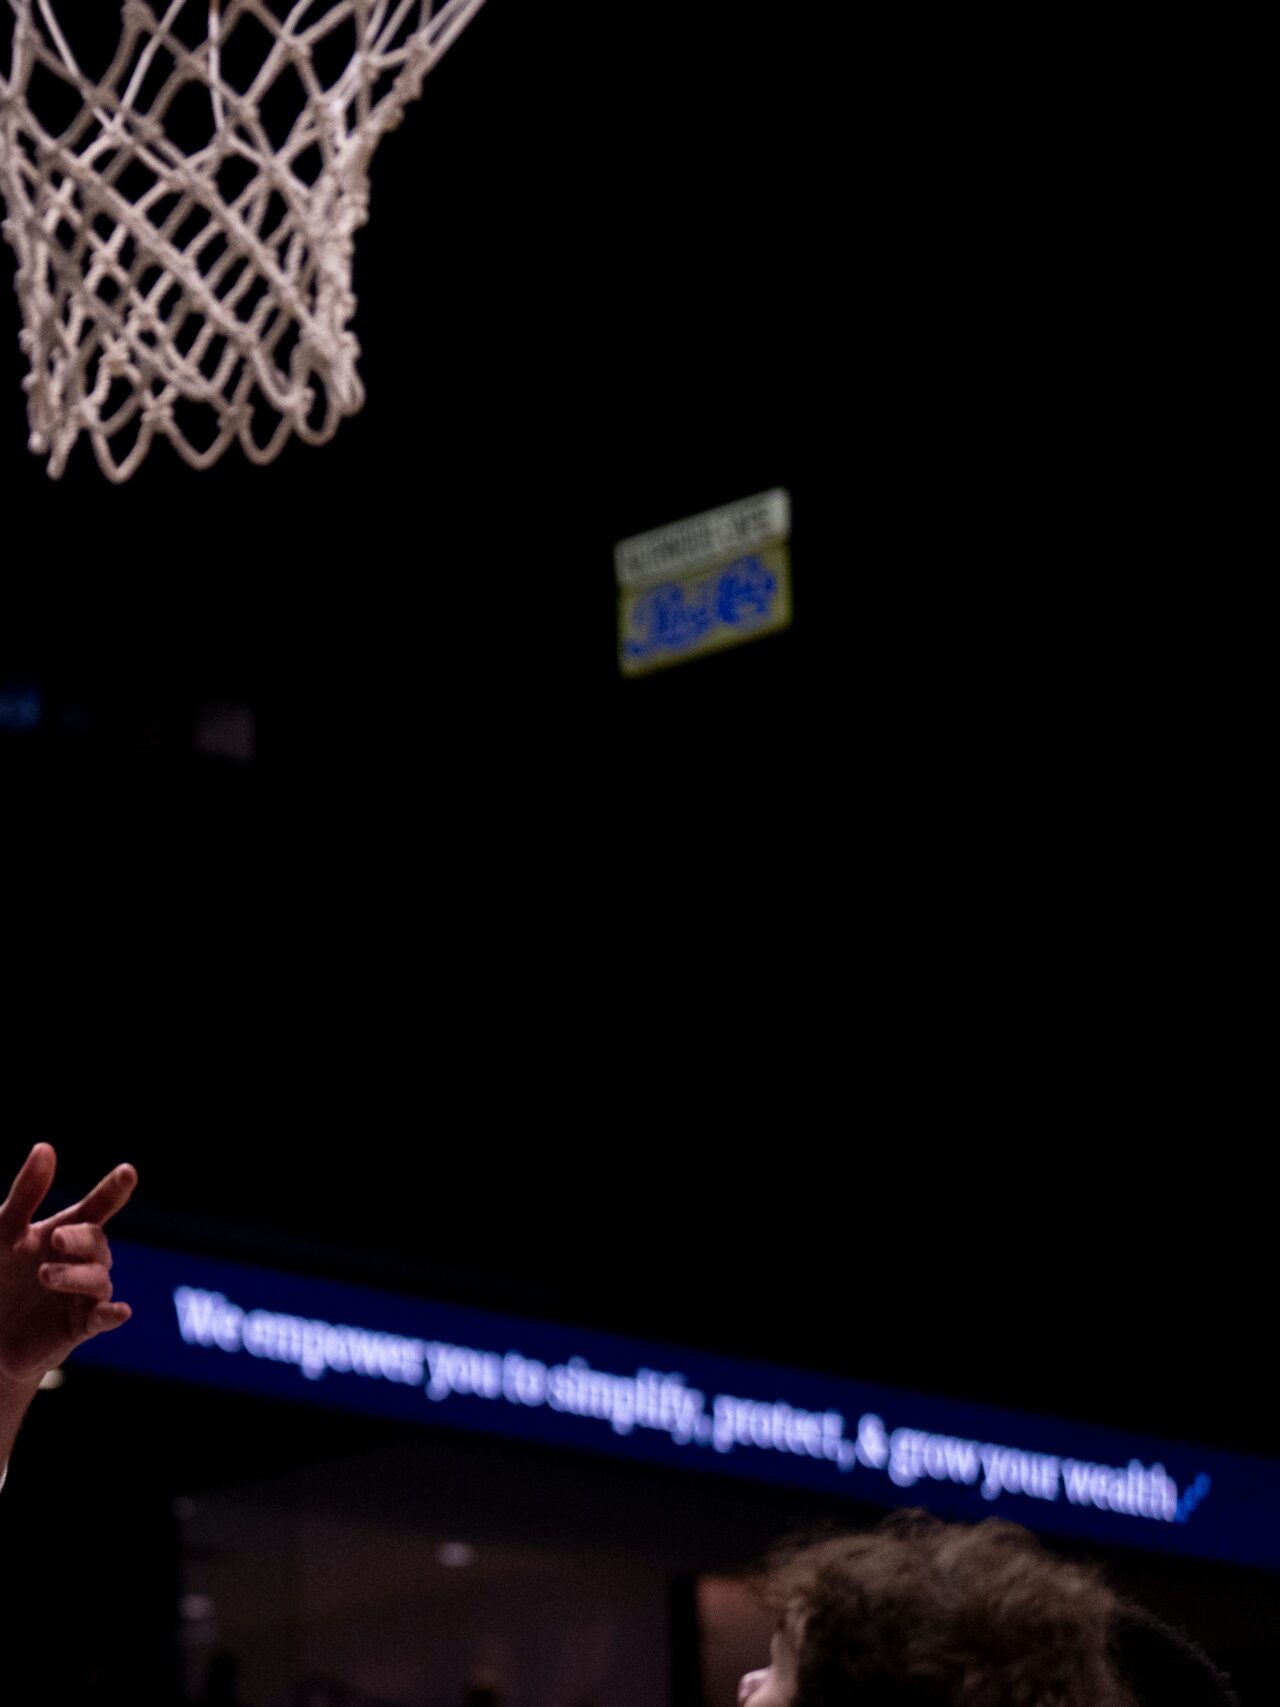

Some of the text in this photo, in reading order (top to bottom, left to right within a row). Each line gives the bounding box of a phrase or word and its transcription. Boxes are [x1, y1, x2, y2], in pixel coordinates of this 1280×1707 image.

[174, 1286, 1179, 1522] We empower you to simplify, protect, & grow your wealth
